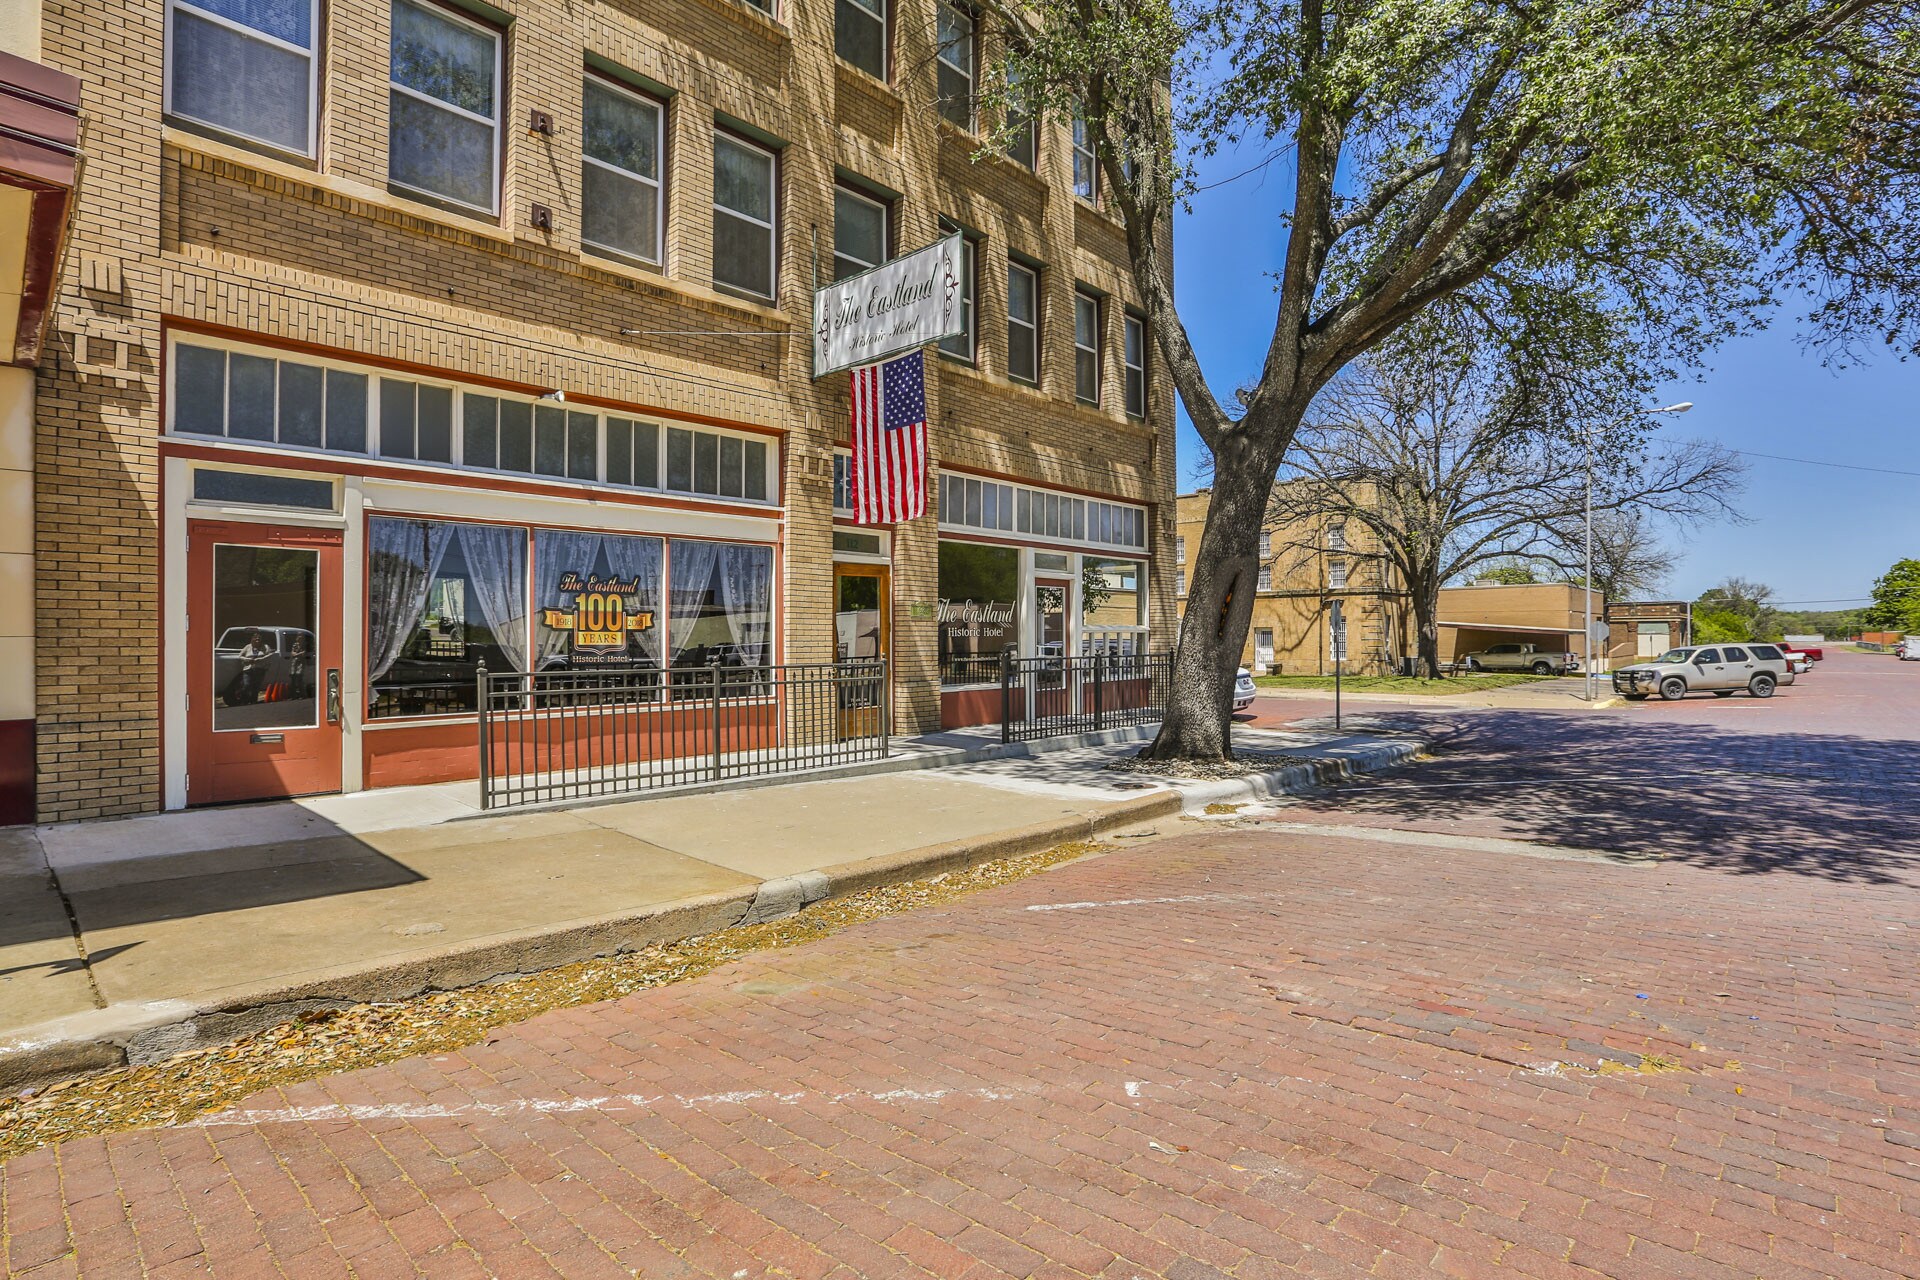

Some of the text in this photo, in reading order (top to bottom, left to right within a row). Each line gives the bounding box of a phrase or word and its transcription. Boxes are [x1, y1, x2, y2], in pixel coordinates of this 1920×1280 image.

[835, 262, 938, 331] The Eastland
[848, 315, 919, 351] Historic Hotel
[561, 573, 639, 593] The Eastland
[575, 593, 623, 631] 100
[937, 598, 1016, 623] The Eastland
[556, 617, 572, 626] 1918
[627, 618, 644, 627] 2018
[582, 633, 618, 643] YEARS
[948, 627, 1004, 637] Historic Hotel
[572, 655, 629, 663] Historic Hotel
